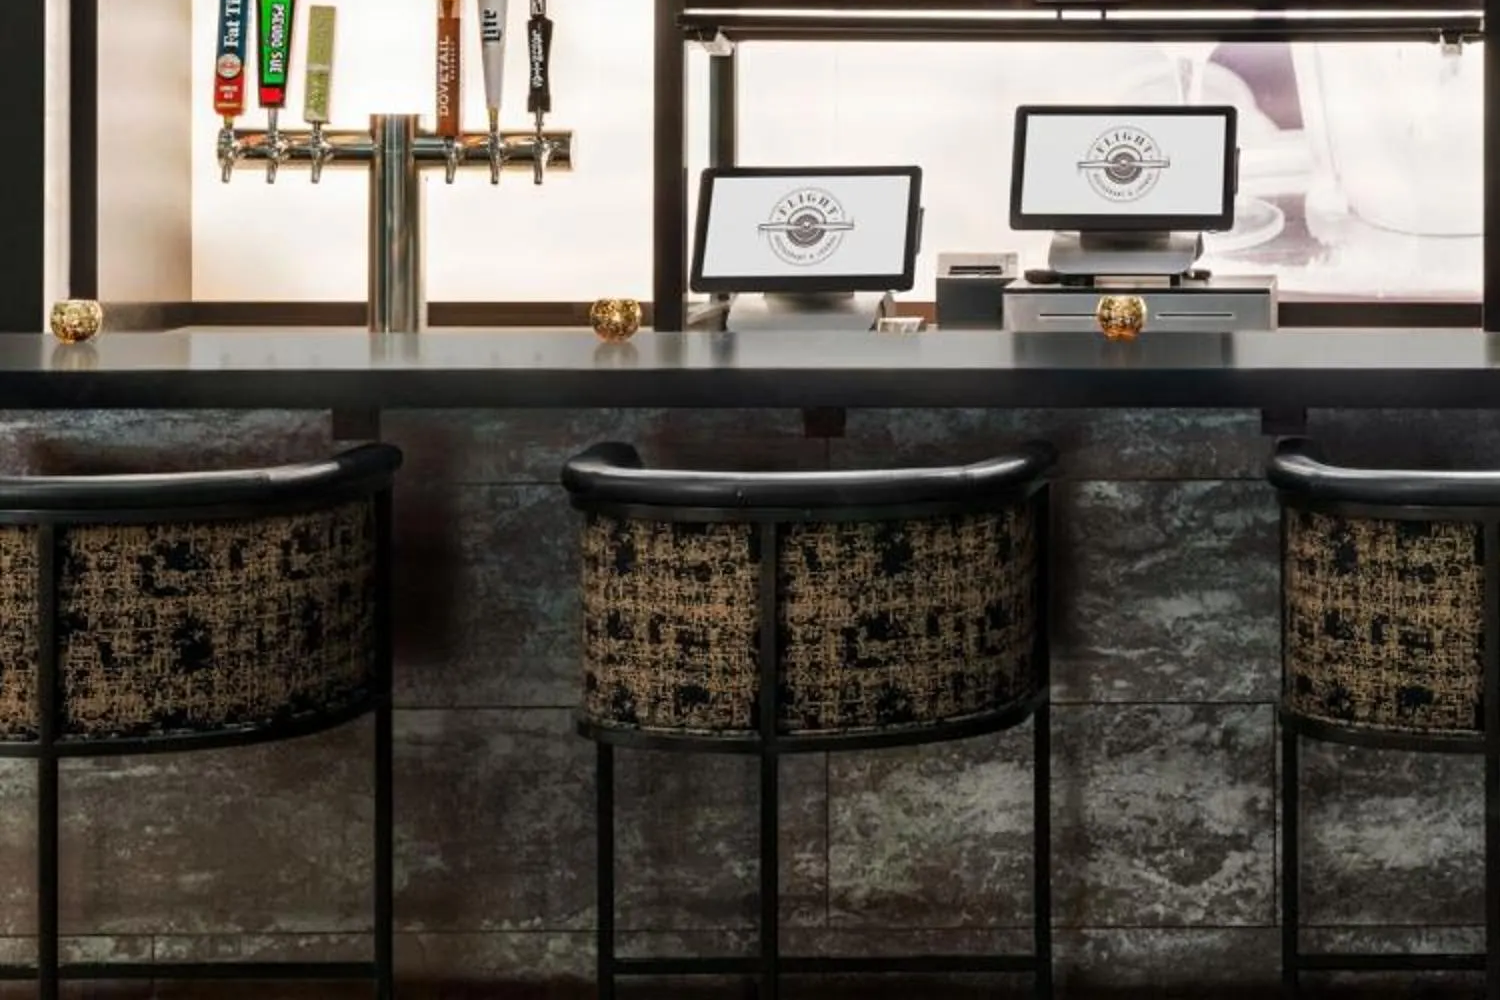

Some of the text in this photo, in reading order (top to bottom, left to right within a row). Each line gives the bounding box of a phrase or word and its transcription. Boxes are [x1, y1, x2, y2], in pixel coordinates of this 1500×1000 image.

[223, 18, 240, 49] Fat
[269, 3, 285, 73] PSEUDO SUE
[482, 9, 501, 43] Lite
[439, 35, 450, 117] DOVETAIL
[1095, 131, 1152, 154] FLIGHT
[778, 193, 837, 216] FLIGHT
